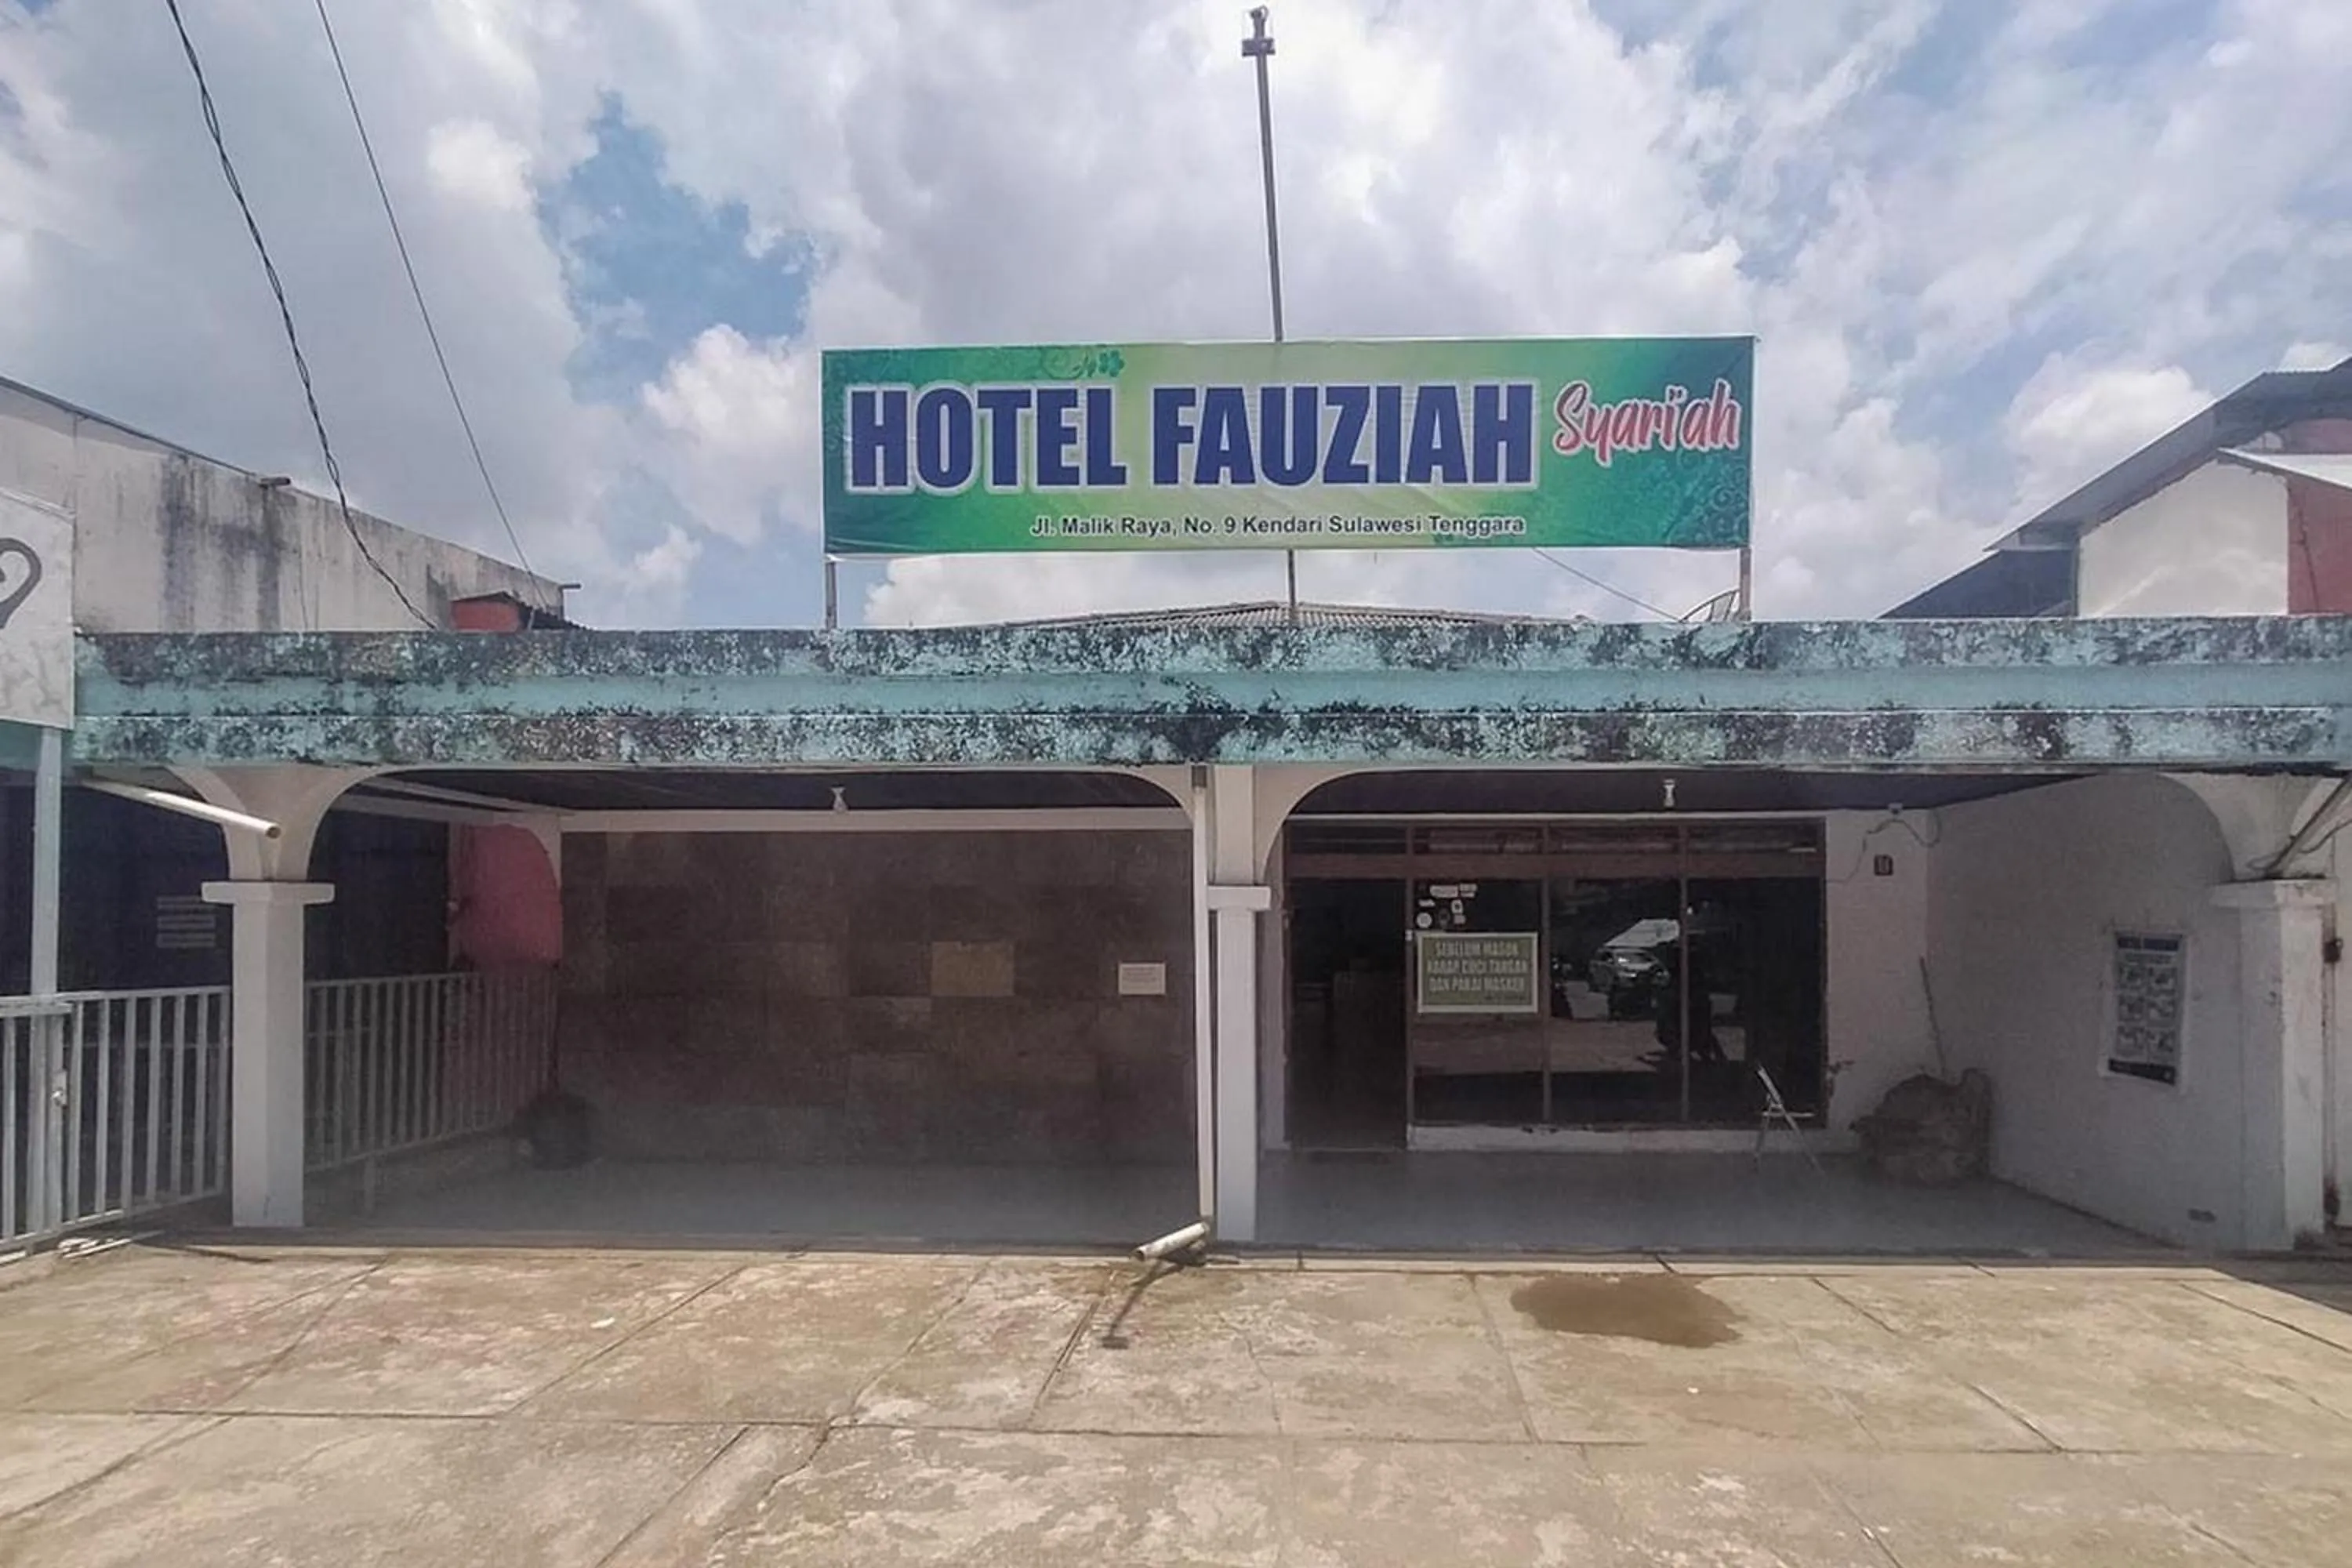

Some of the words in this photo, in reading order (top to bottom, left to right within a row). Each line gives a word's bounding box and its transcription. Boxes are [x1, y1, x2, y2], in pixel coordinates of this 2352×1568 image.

[850, 387, 1127, 488] HOTEL
[1152, 384, 1534, 485] FAUZIAH
[1031, 517, 1054, 535] Jl.
[1062, 516, 1114, 535] Malik
[1120, 516, 1177, 538] Raya,
[1183, 516, 1217, 535] No.
[1223, 516, 1237, 535] 9
[1242, 515, 1323, 535] Kendari
[1327, 514, 1421, 534] Sulawesi
[1428, 514, 1525, 536] Tenggara
